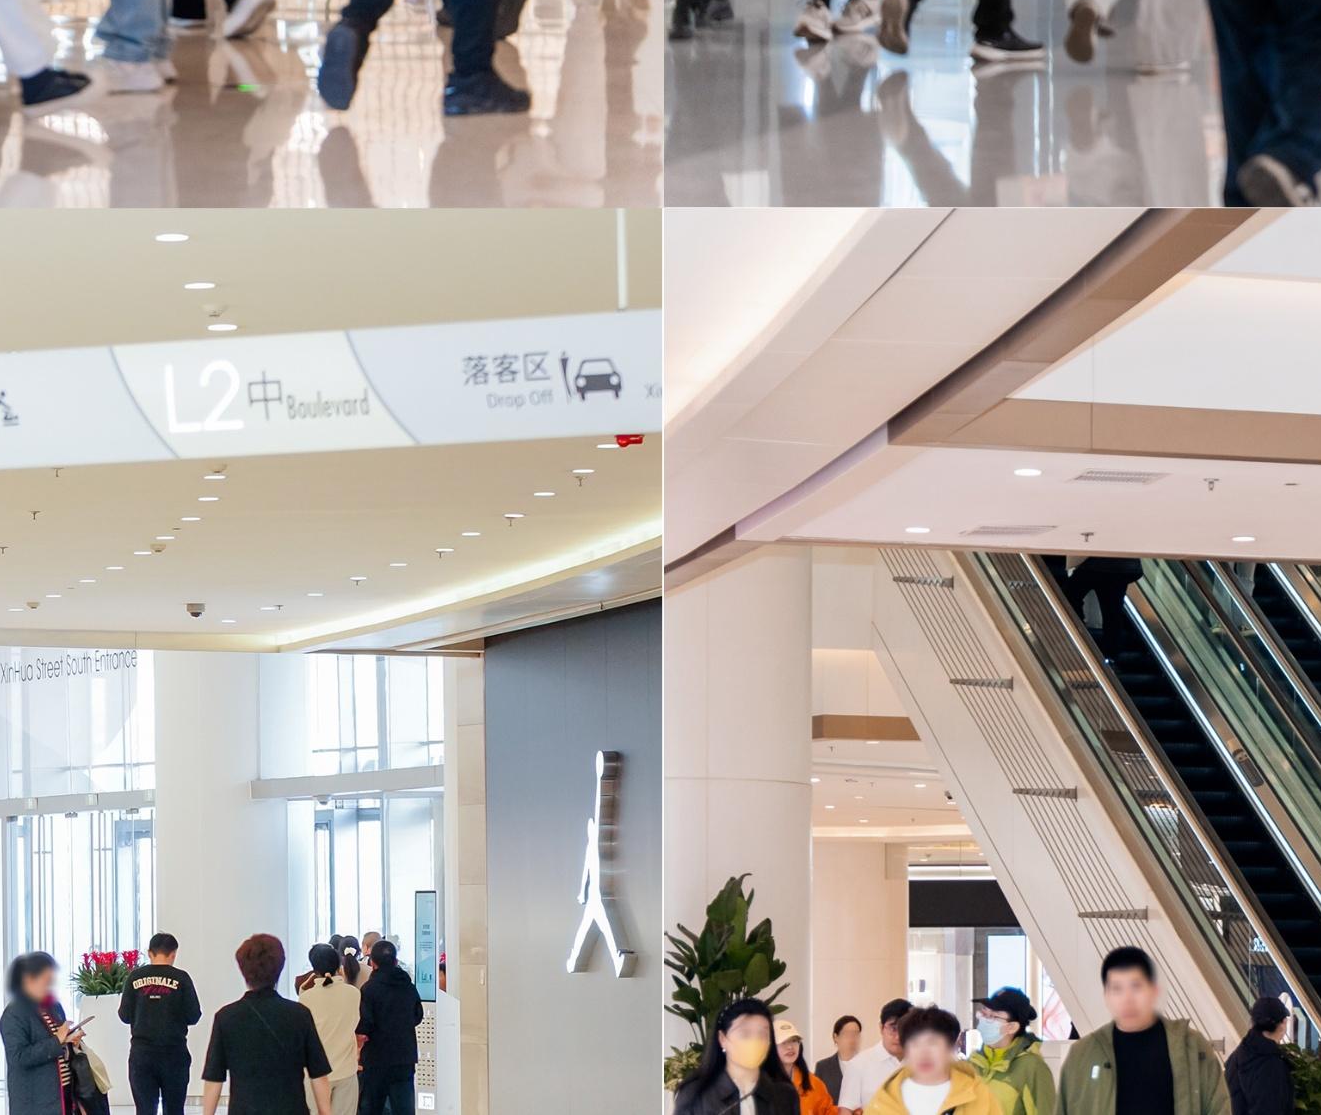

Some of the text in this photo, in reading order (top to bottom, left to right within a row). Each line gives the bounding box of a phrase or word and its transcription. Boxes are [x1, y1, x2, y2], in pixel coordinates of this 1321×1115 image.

[463, 351, 551, 386] 落客区
[164, 360, 245, 433] L2
[247, 370, 282, 421] 中
[286, 389, 371, 420] Boulevard
[486, 389, 553, 409] Drop Off
[0, 649, 138, 684] XinHua Street South Entrance
[133, 976, 179, 990] ORIGINALE
